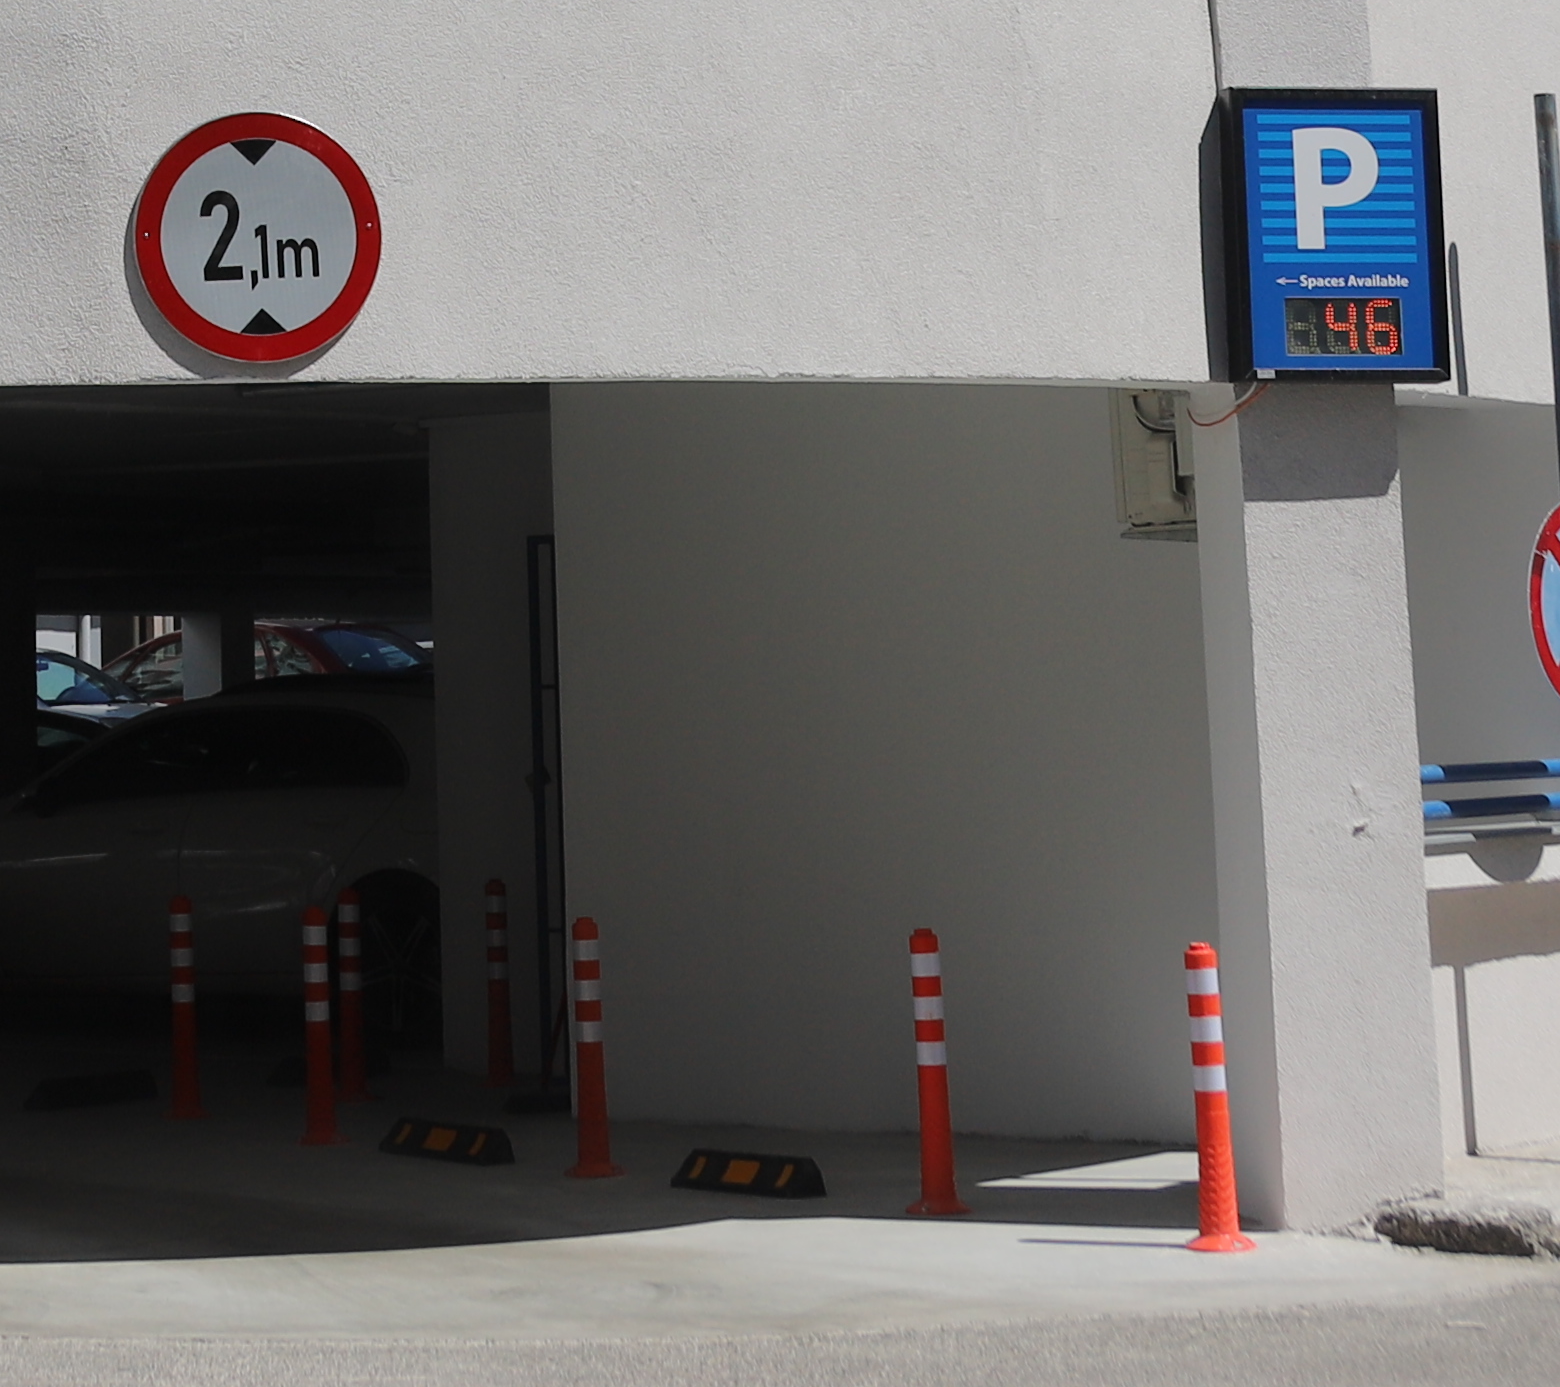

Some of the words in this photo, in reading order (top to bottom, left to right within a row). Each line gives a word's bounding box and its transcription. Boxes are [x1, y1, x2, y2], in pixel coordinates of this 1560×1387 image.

[1291, 126, 1380, 250] P
[199, 190, 320, 291] 2,1m
[1299, 274, 1346, 290] Spaces
[1347, 274, 1410, 287] Available
[1325, 298, 1398, 355] 46
